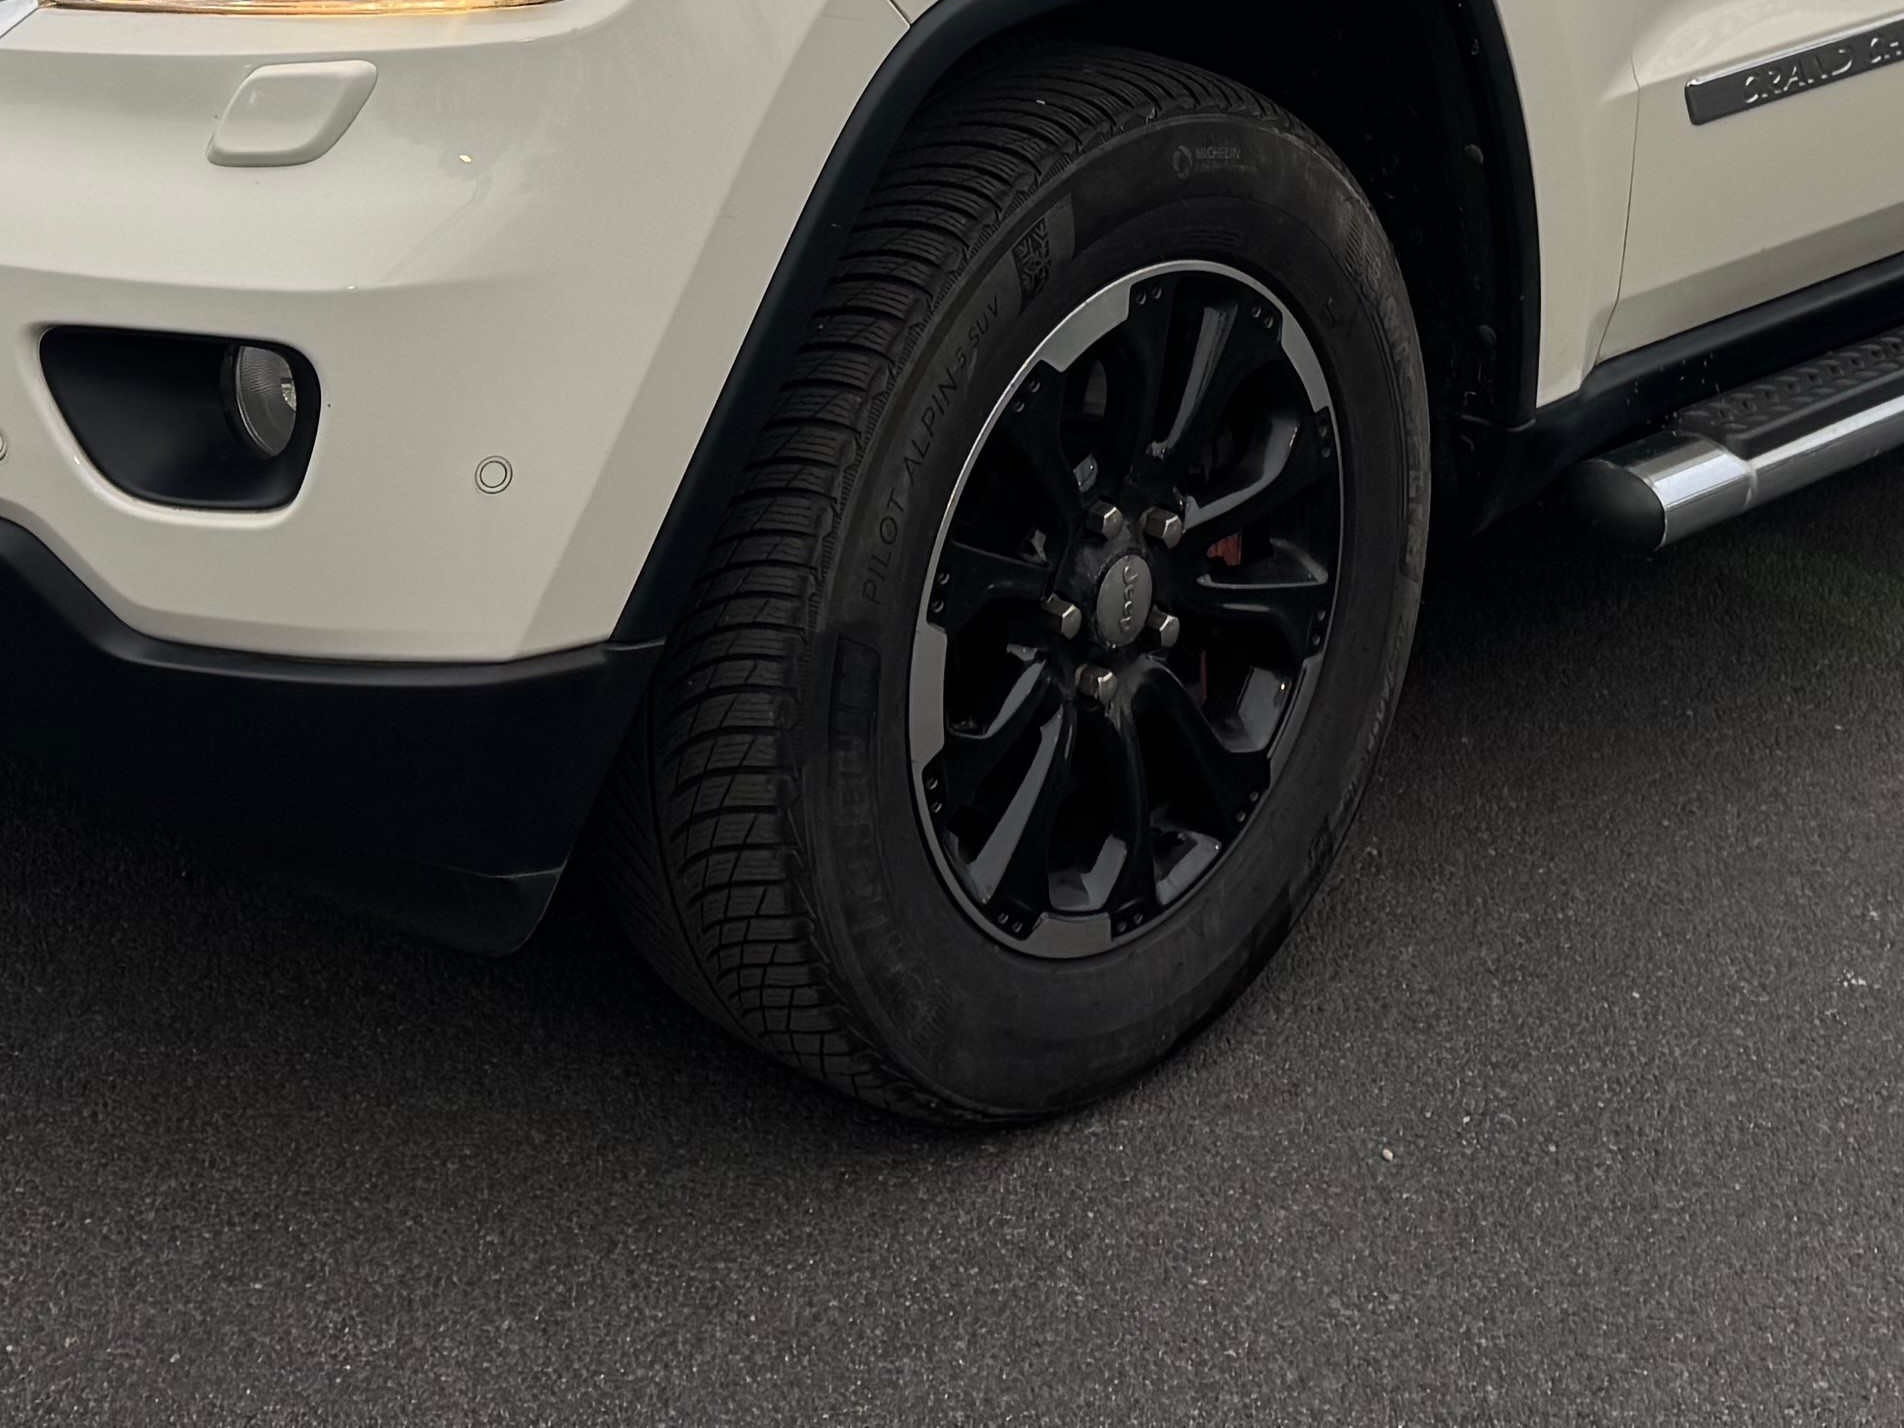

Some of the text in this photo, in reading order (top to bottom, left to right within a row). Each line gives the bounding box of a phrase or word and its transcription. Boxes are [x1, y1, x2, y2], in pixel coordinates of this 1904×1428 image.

[1742, 48, 1855, 106] GRAND
[862, 294, 1000, 606] PILOT ALPIN 5 SUV
[1119, 563, 1140, 634] Jeep
